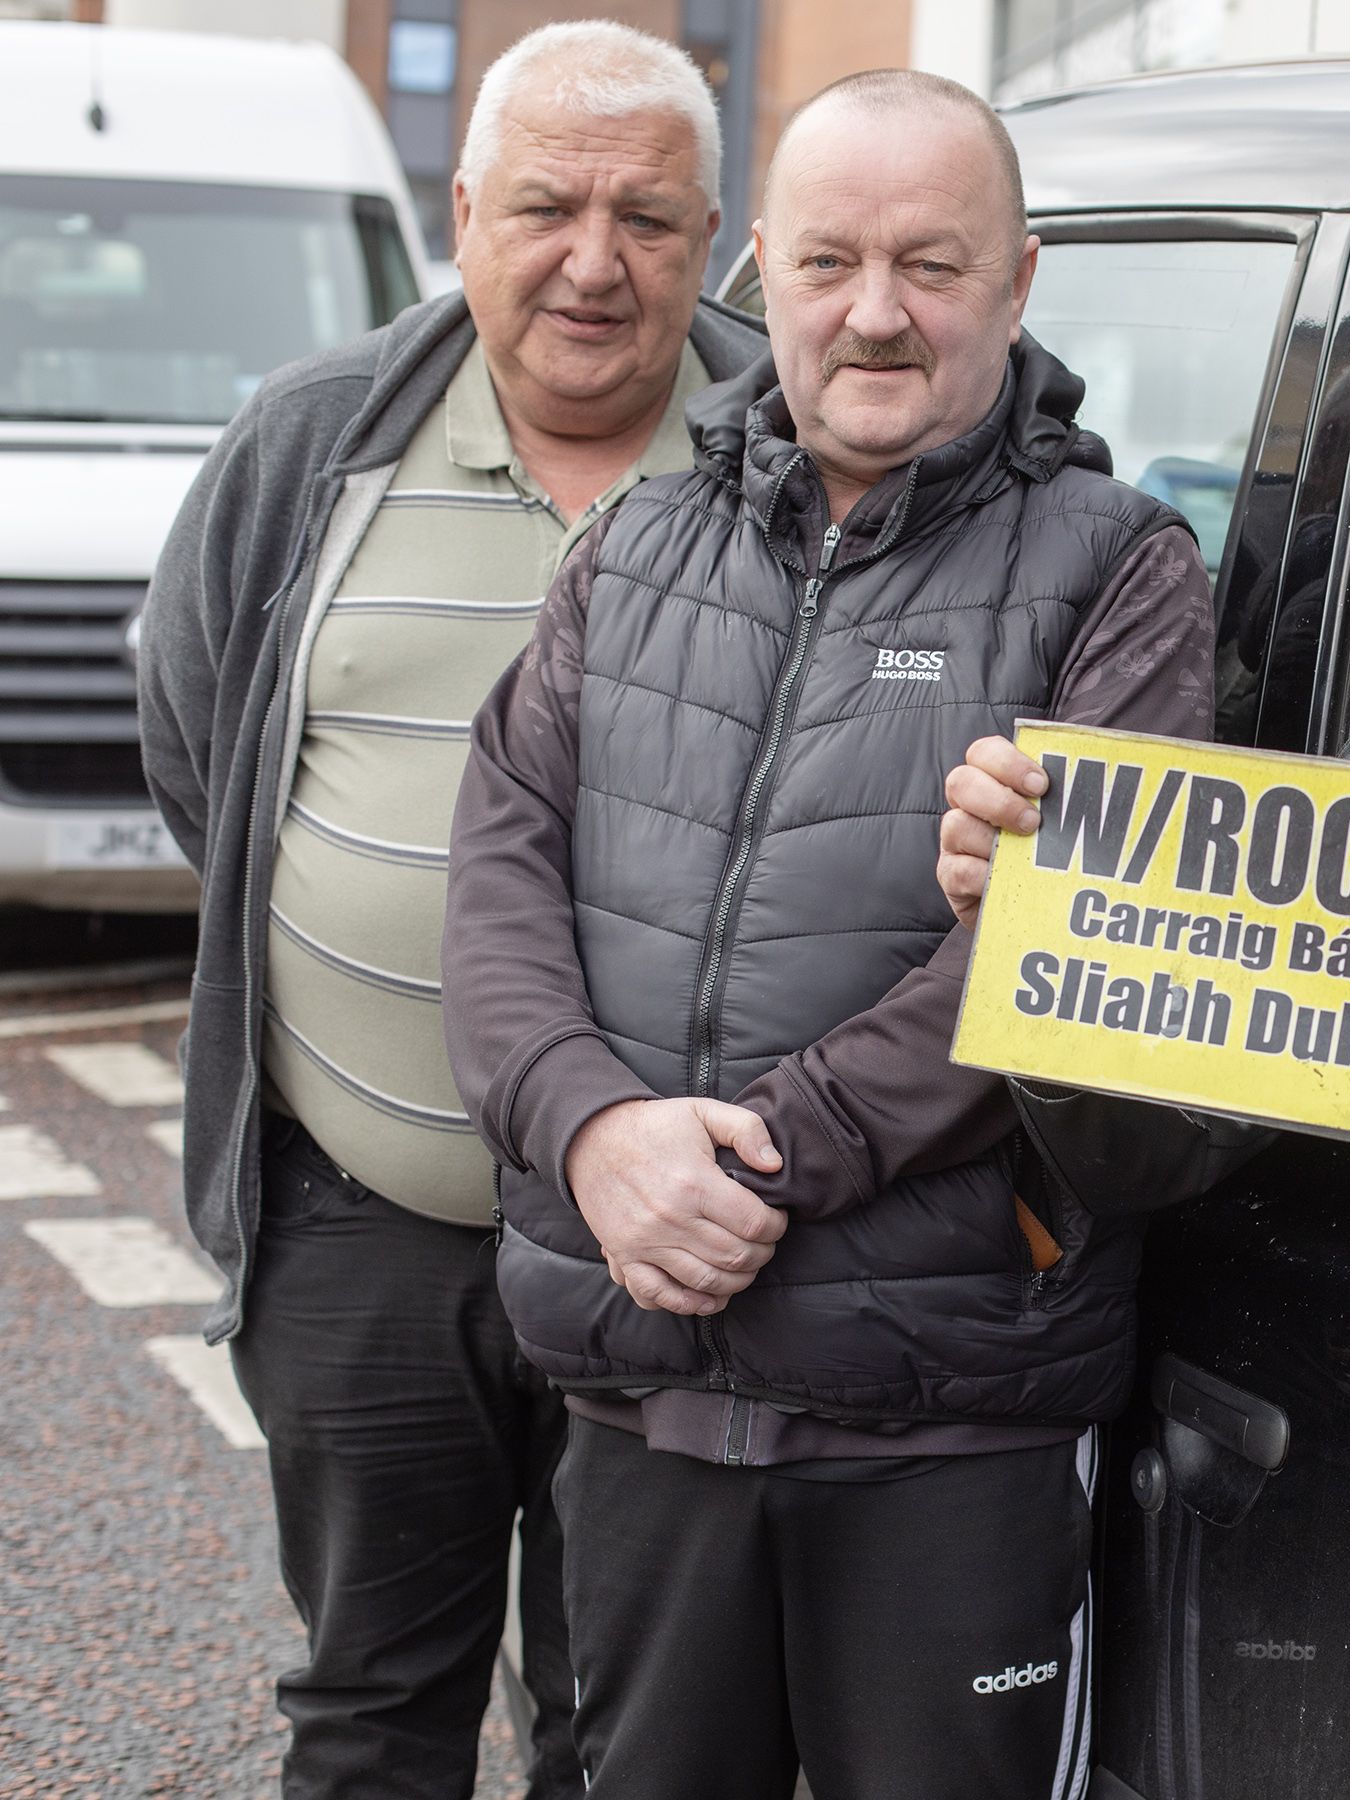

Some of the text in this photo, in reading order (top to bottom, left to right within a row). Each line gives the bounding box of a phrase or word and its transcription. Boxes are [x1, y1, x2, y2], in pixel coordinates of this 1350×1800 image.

[872, 670, 941, 681] HUGO BOSS
[875, 648, 945, 670] BOSS
[1069, 890, 1277, 970] Carraig
[1015, 951, 1232, 1045] Sliabh
[972, 1660, 1058, 1694] adidas
